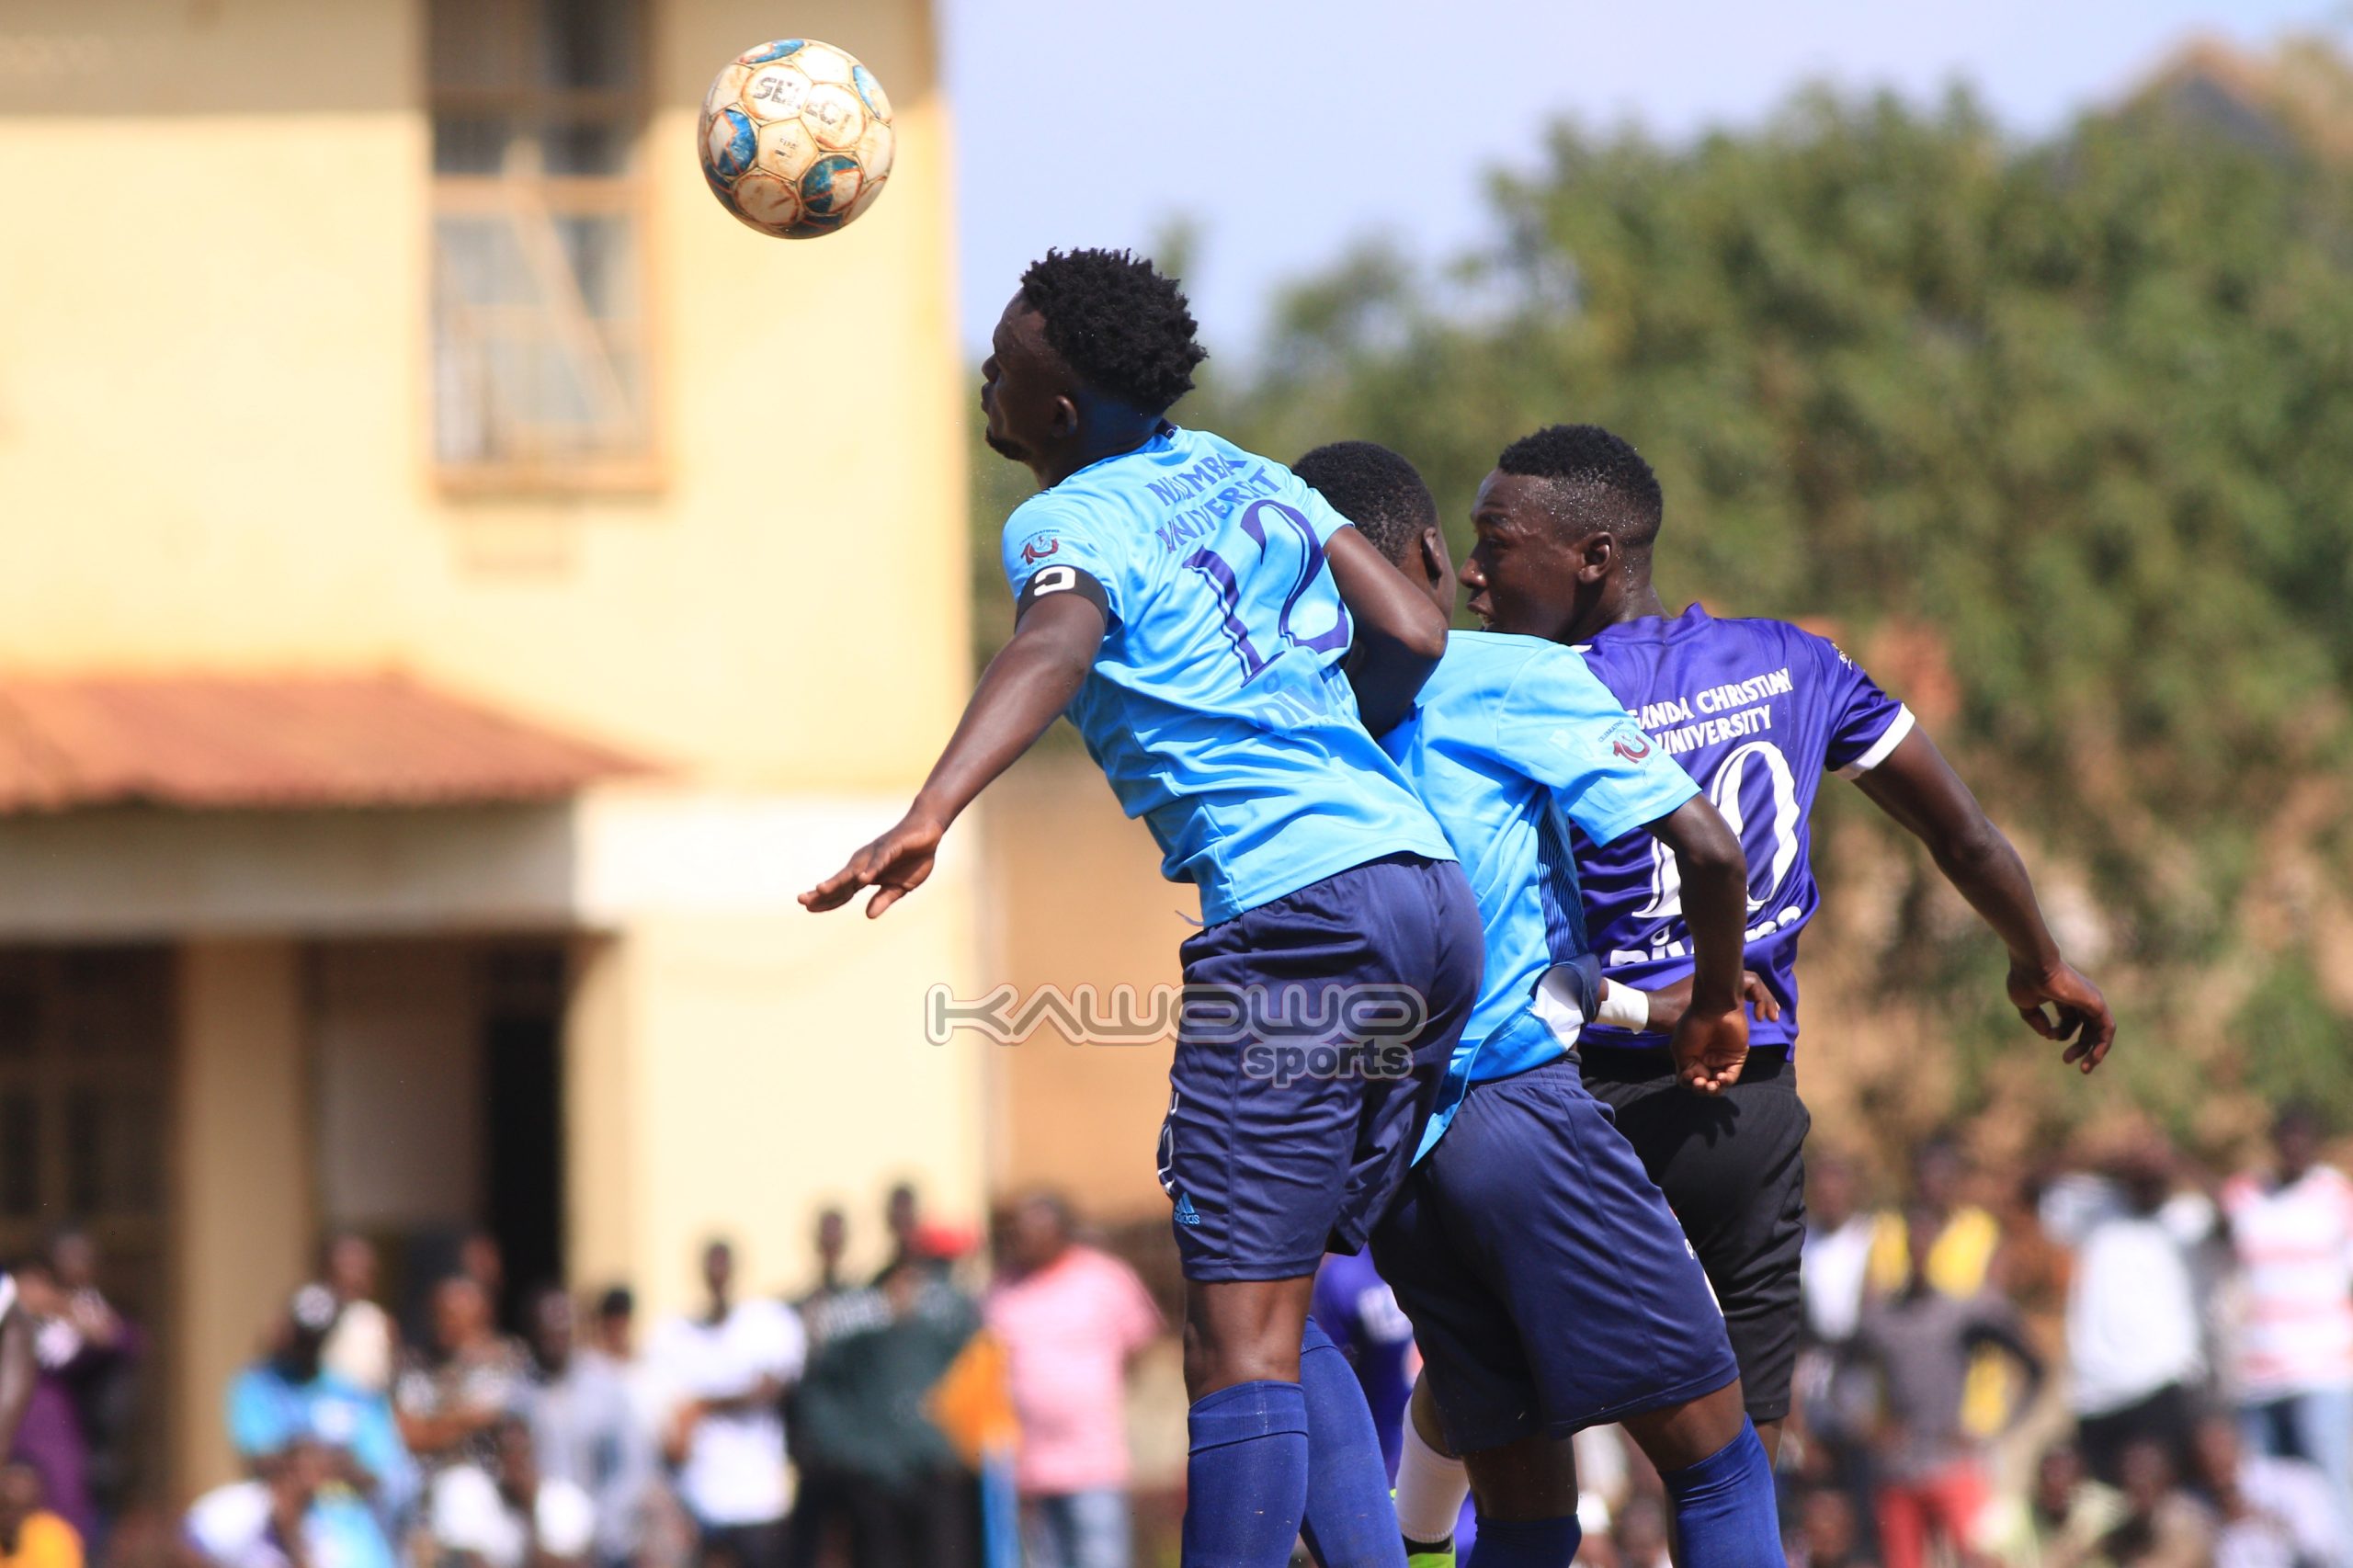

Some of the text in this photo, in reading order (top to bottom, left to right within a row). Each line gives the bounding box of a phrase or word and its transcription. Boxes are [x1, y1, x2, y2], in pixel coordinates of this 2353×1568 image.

[752, 76, 853, 133] SEECT
[1182, 499, 1349, 688] 12
[1627, 667, 1794, 732] GANDA CHRISTIAN
[1655, 704, 1772, 756] UNIVERSITY
[1175, 1210, 1200, 1226] adidas
